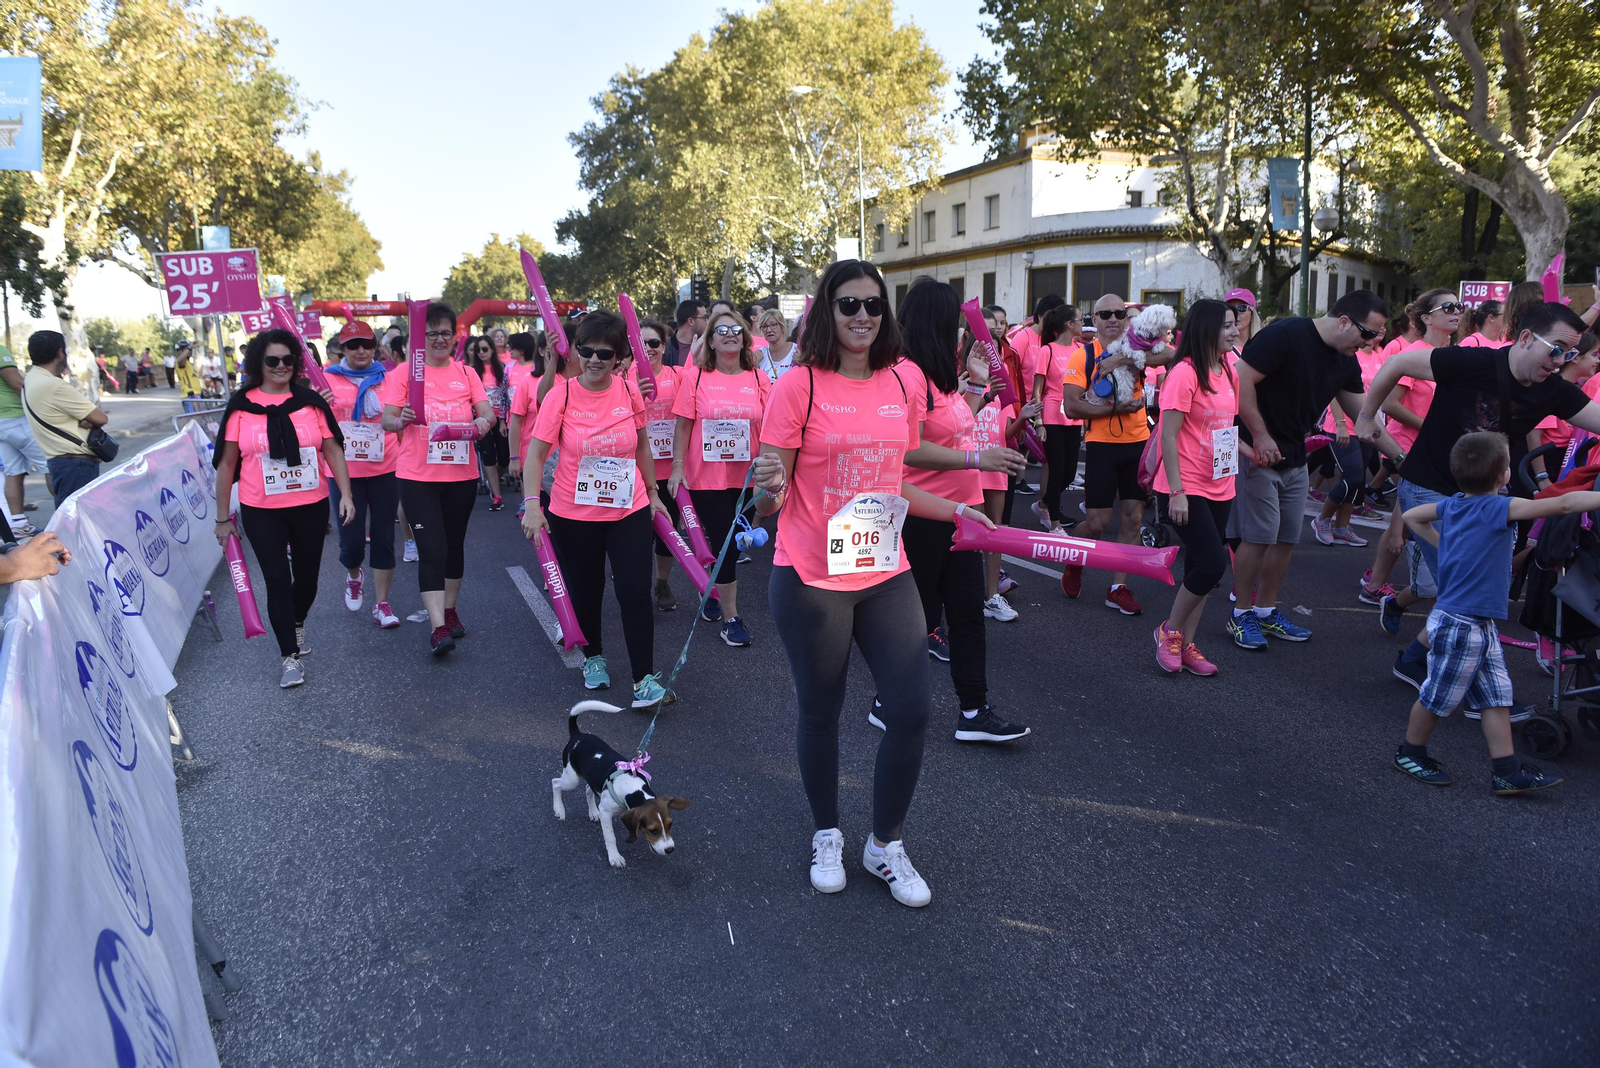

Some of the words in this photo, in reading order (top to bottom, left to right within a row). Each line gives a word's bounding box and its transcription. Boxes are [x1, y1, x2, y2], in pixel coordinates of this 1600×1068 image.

[166, 256, 214, 277] SUB
[227, 273, 257, 281] OYSHO
[1464, 284, 1488, 297] SUB
[354, 302, 391, 310] Santander
[415, 348, 426, 382] Ladival
[821, 403, 857, 413] OYSHO
[572, 410, 597, 418] OYSHO
[653, 438, 671, 447] 016
[715, 439, 736, 448] 016
[825, 433, 842, 444] HOY
[846, 434, 872, 444] GANAN
[351, 440, 371, 449] 016
[437, 442, 456, 450] 016
[853, 448, 874, 456] VITORIA
[878, 448, 899, 456] GASTEIZ
[1220, 450, 1232, 462] 016
[596, 463, 620, 471] ASTURIANA
[280, 469, 303, 479] 016
[593, 479, 618, 491] 016
[854, 506, 883, 514] ASTURIANA
[851, 531, 880, 546] 016
[857, 547, 872, 555] 4892
[1031, 542, 1088, 566] Ladival
[230, 559, 250, 593] Ladival
[542, 560, 566, 599] Ladival
